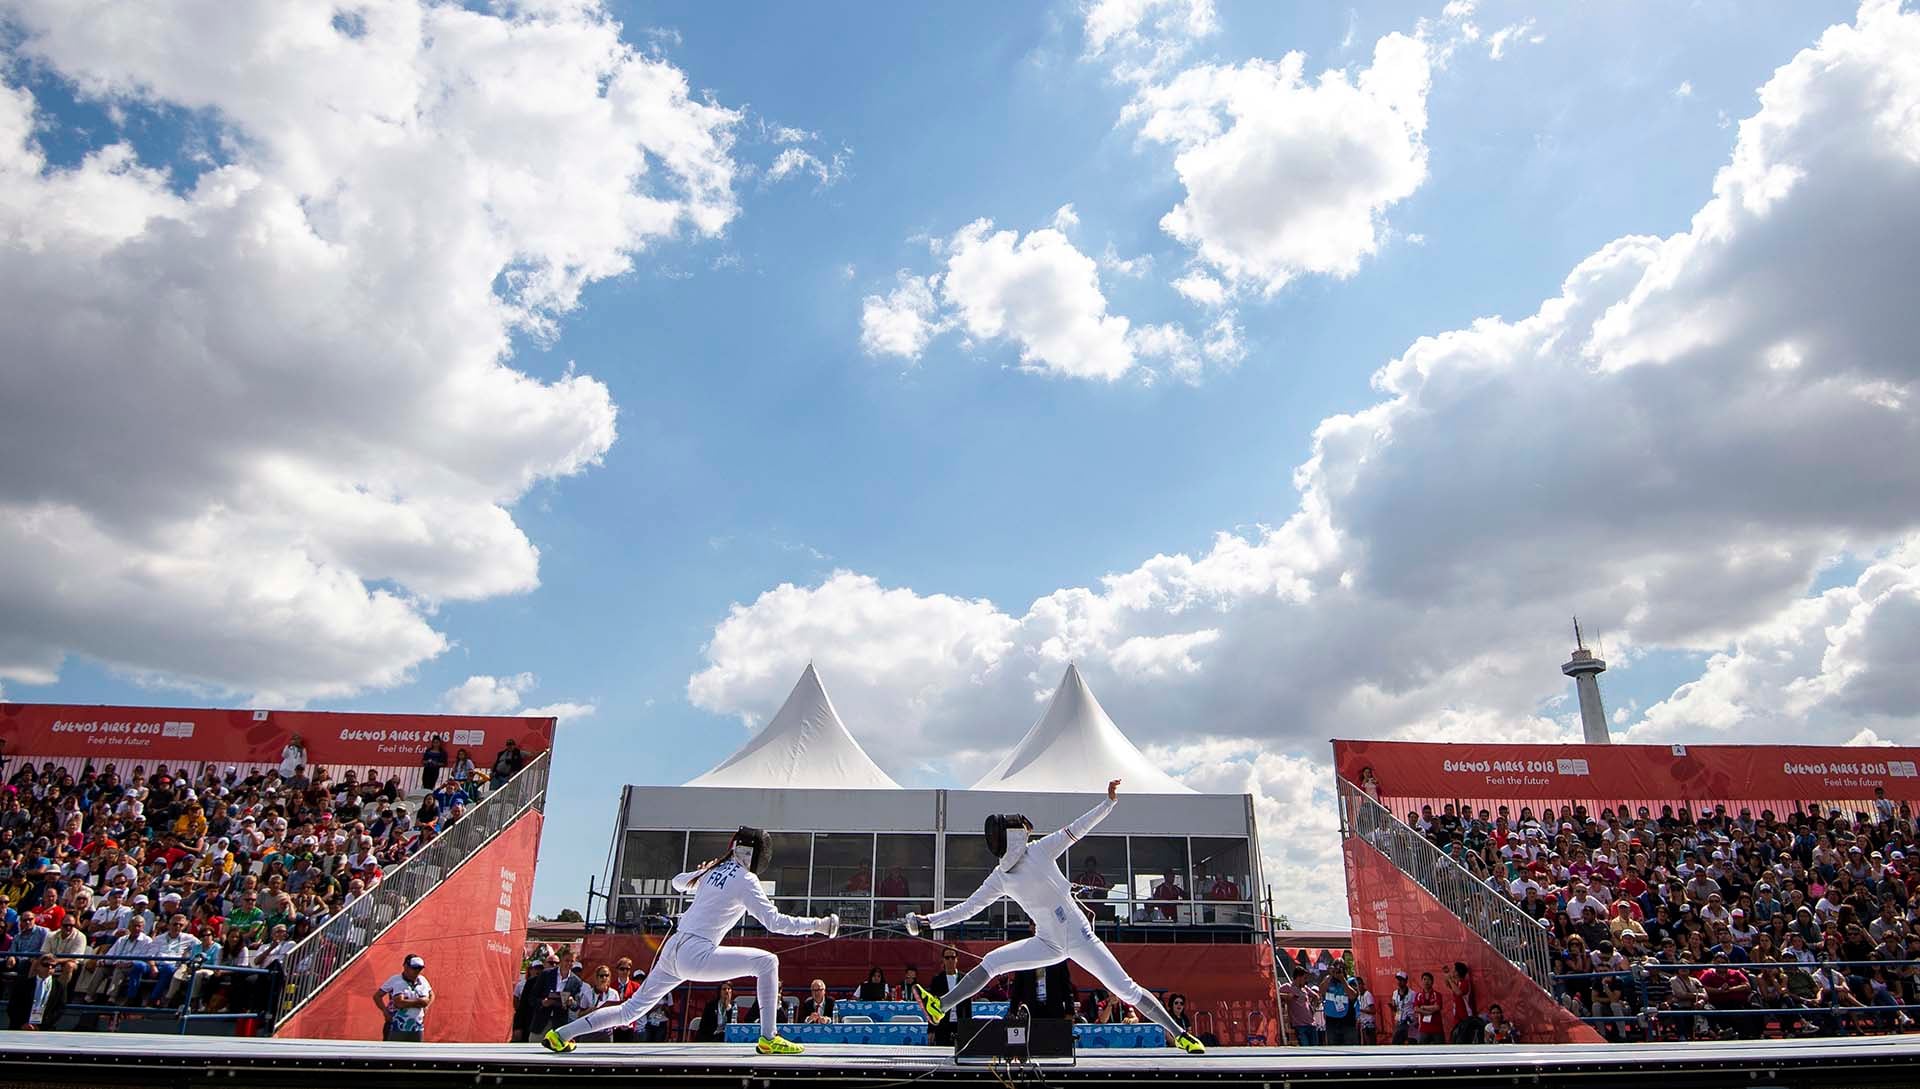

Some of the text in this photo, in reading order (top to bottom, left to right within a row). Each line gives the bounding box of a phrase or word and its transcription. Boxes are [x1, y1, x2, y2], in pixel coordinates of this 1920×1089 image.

[52, 720, 161, 734] BUENOS AIRES 2018
[87, 735, 151, 746] Feel the future
[339, 728, 387, 741] BUENOS
[388, 730, 421, 741] AIRES
[377, 744, 396, 753] Feel
[399, 744, 413, 753] the
[1443, 760, 1555, 773] BUENOS AIRES 2018
[1783, 762, 1828, 775] BUENOS
[1829, 762, 1859, 775] AIRES
[1861, 763, 1887, 775] 2018
[1486, 775, 1550, 785] Feel the future
[1823, 778, 1883, 787] Feel the future
[706, 871, 728, 890] FRA
